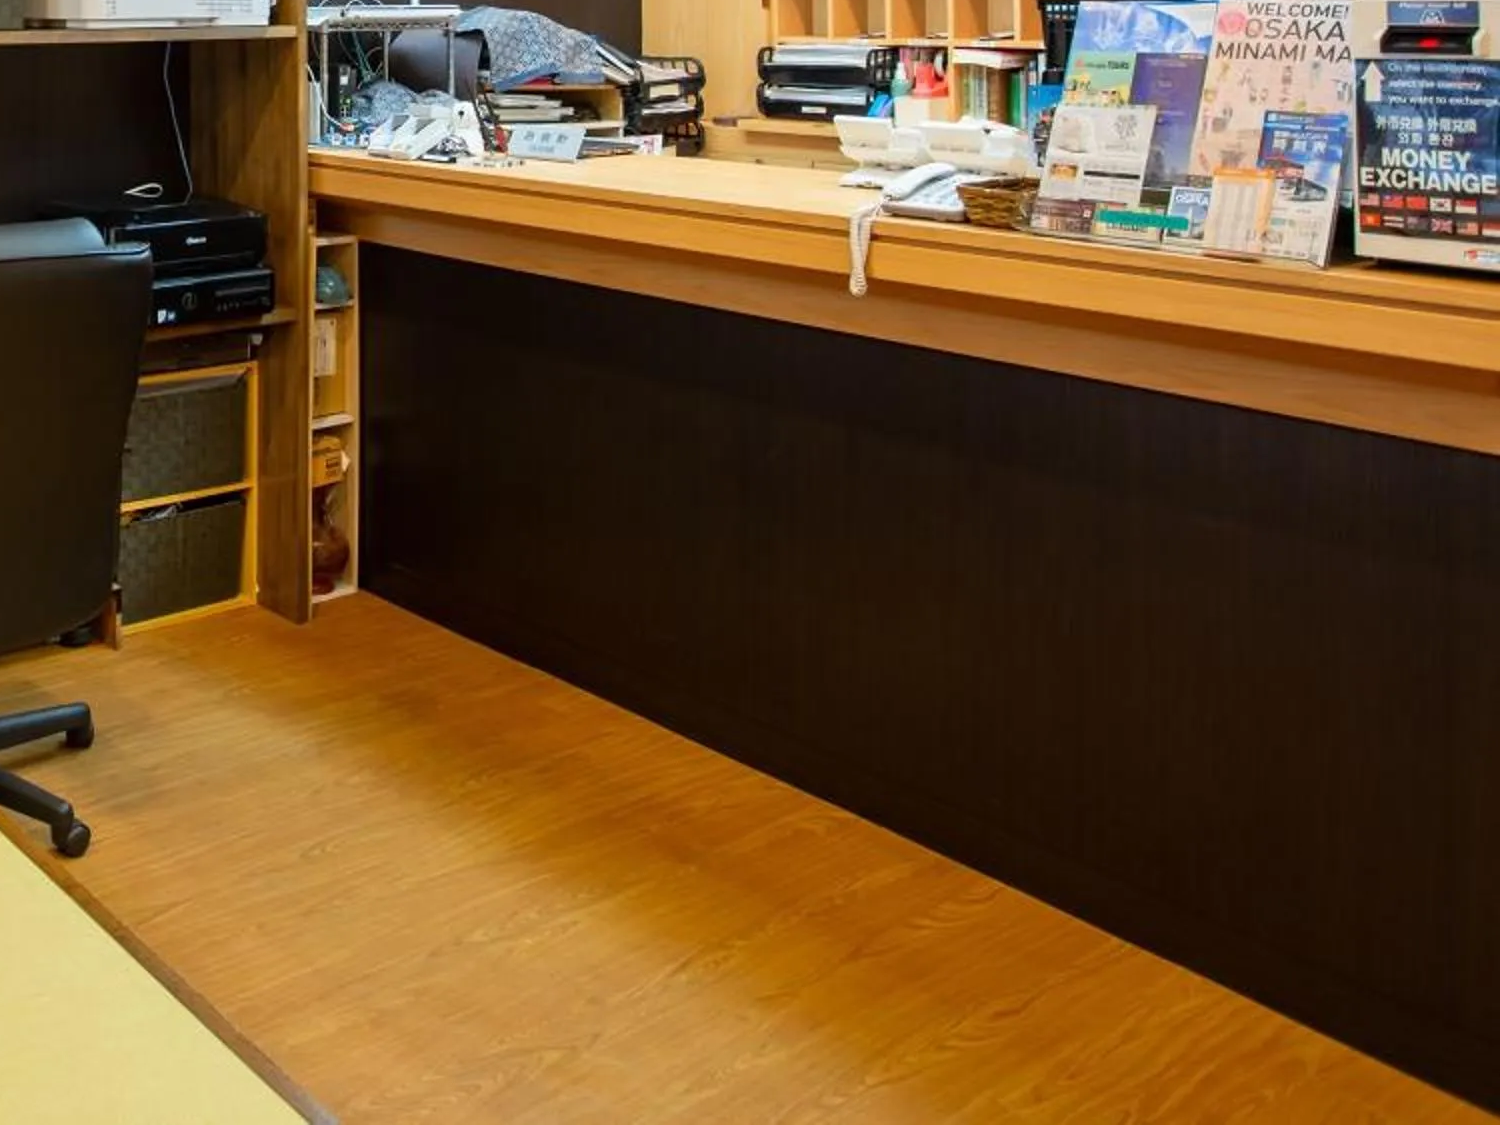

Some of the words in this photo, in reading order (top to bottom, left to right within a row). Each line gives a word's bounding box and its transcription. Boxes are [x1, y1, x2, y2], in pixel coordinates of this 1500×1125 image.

[1247, 2, 1349, 19] WELCOME!
[1245, 18, 1345, 42] OSAKA
[1215, 42, 1307, 62] MINAMI
[1382, 147, 1471, 171] MONEY
[1360, 166, 1499, 194] EXCHANGE
